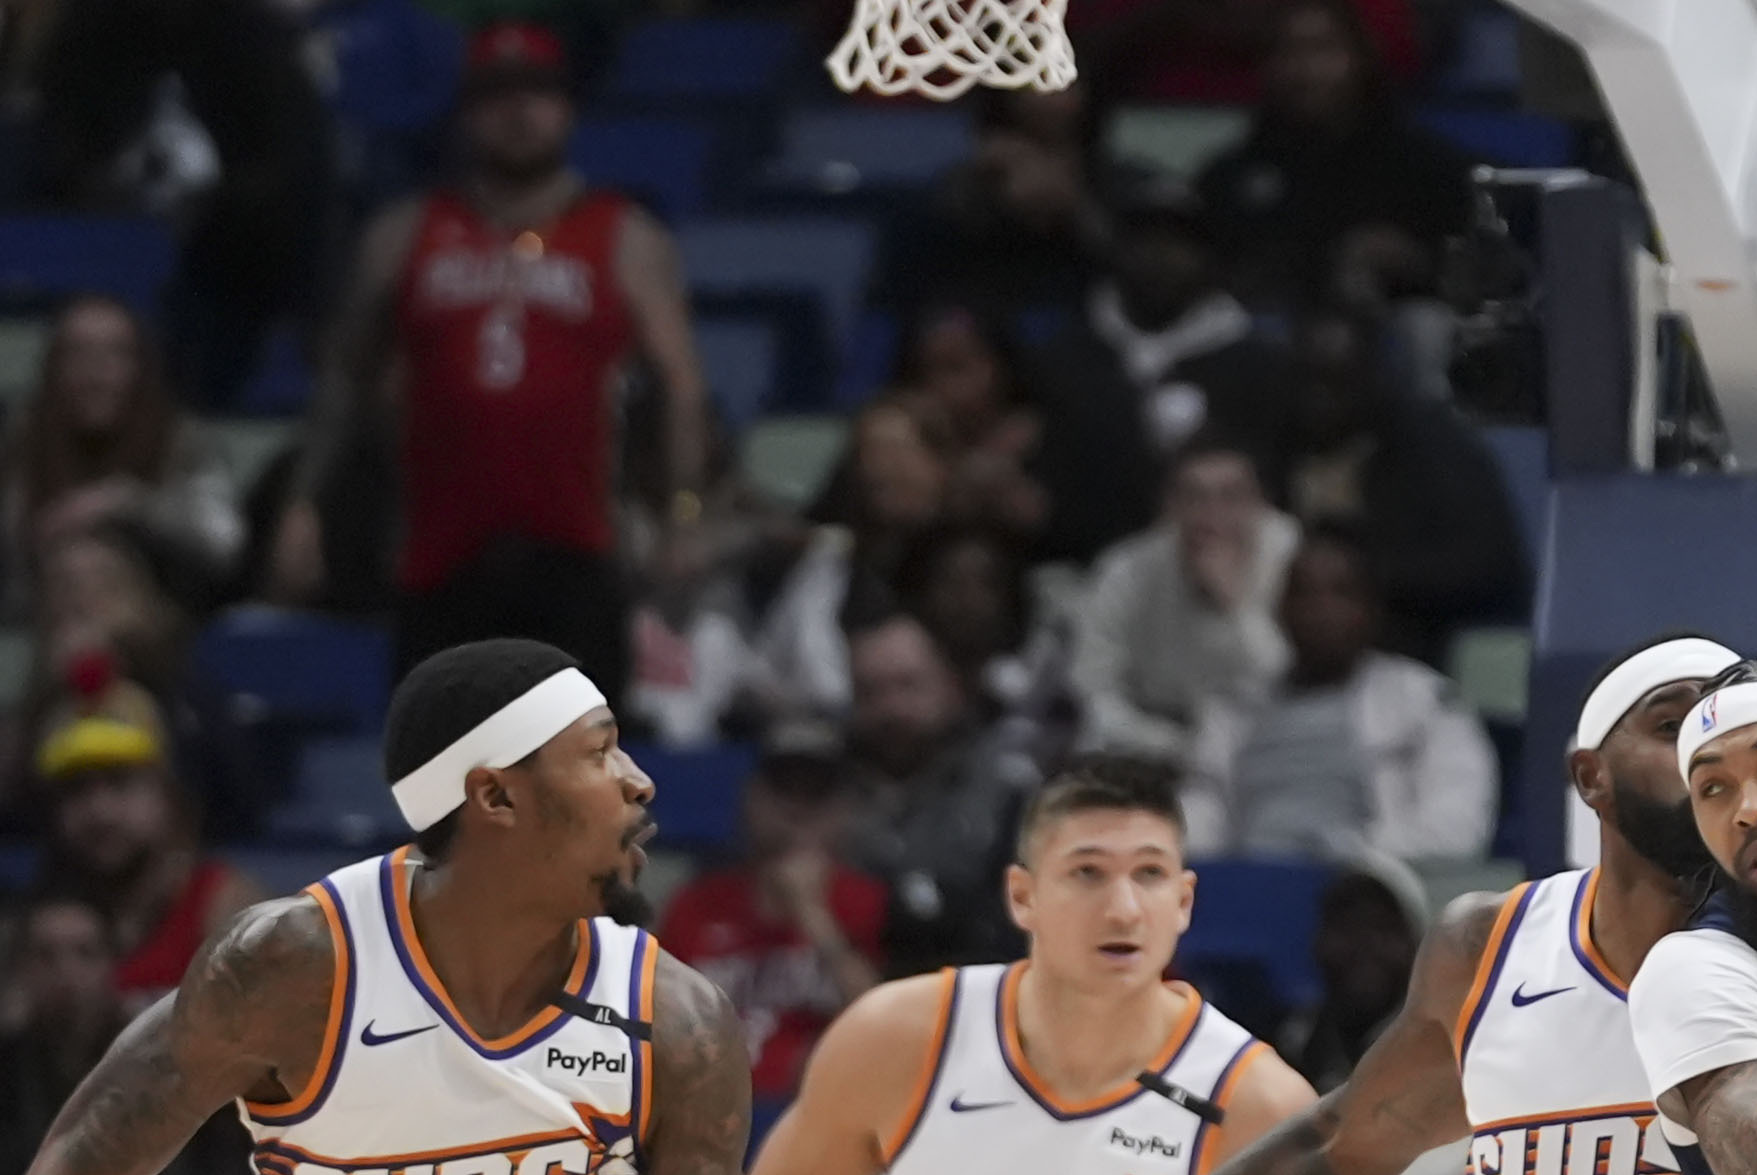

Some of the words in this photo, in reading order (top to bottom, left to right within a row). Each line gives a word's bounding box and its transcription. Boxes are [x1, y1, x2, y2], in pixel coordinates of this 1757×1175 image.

[595, 1006, 612, 1024] AL
[547, 1047, 627, 1077] PayPal
[1110, 1126, 1183, 1159] PayPal
